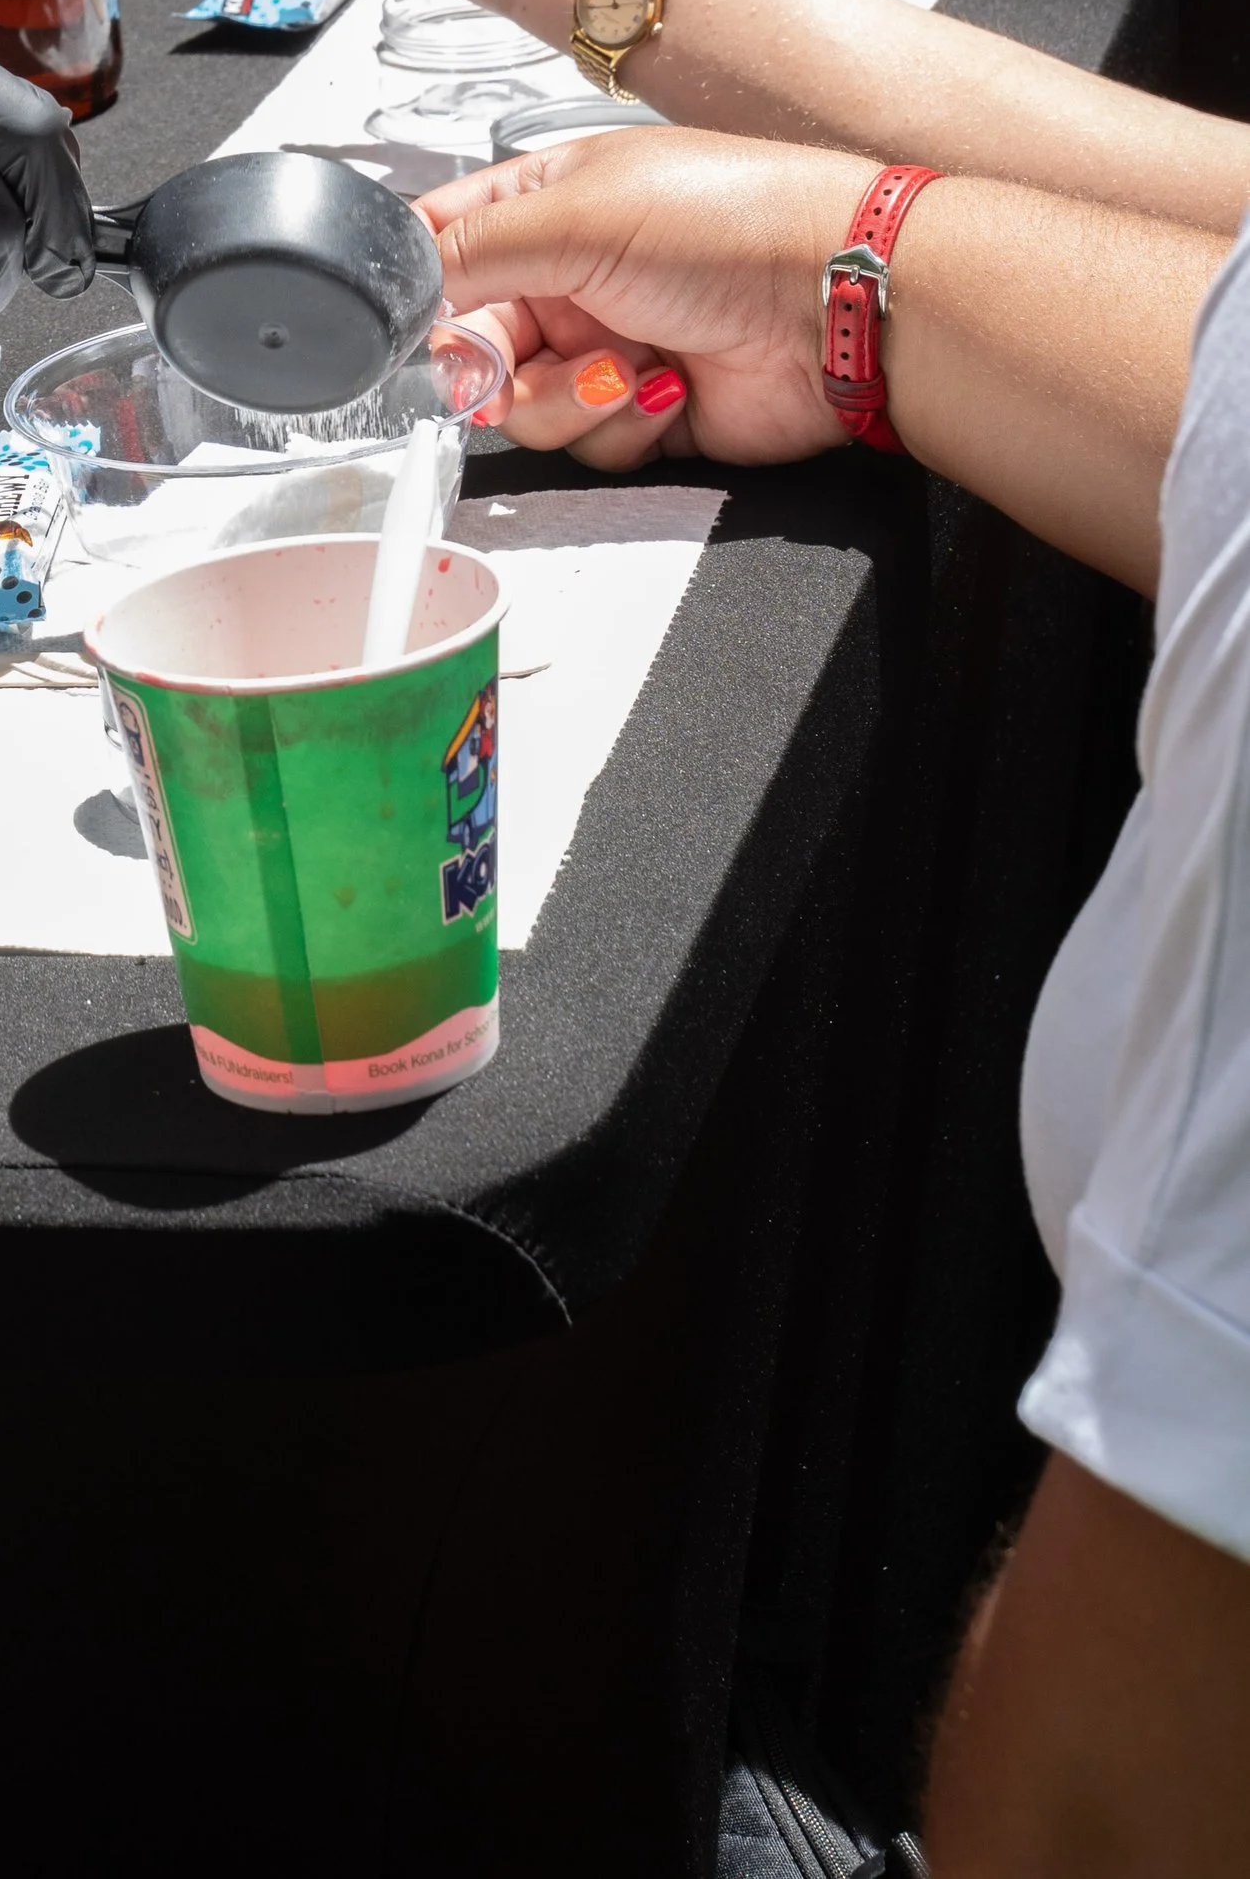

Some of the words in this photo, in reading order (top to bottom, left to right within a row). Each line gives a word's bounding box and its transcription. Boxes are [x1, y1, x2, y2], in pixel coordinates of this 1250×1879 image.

[215, 1053, 294, 1084] FUNdraisers!
[368, 1057, 410, 1079] Book
[410, 1048, 446, 1069] Kona
[446, 1037, 464, 1056] for
